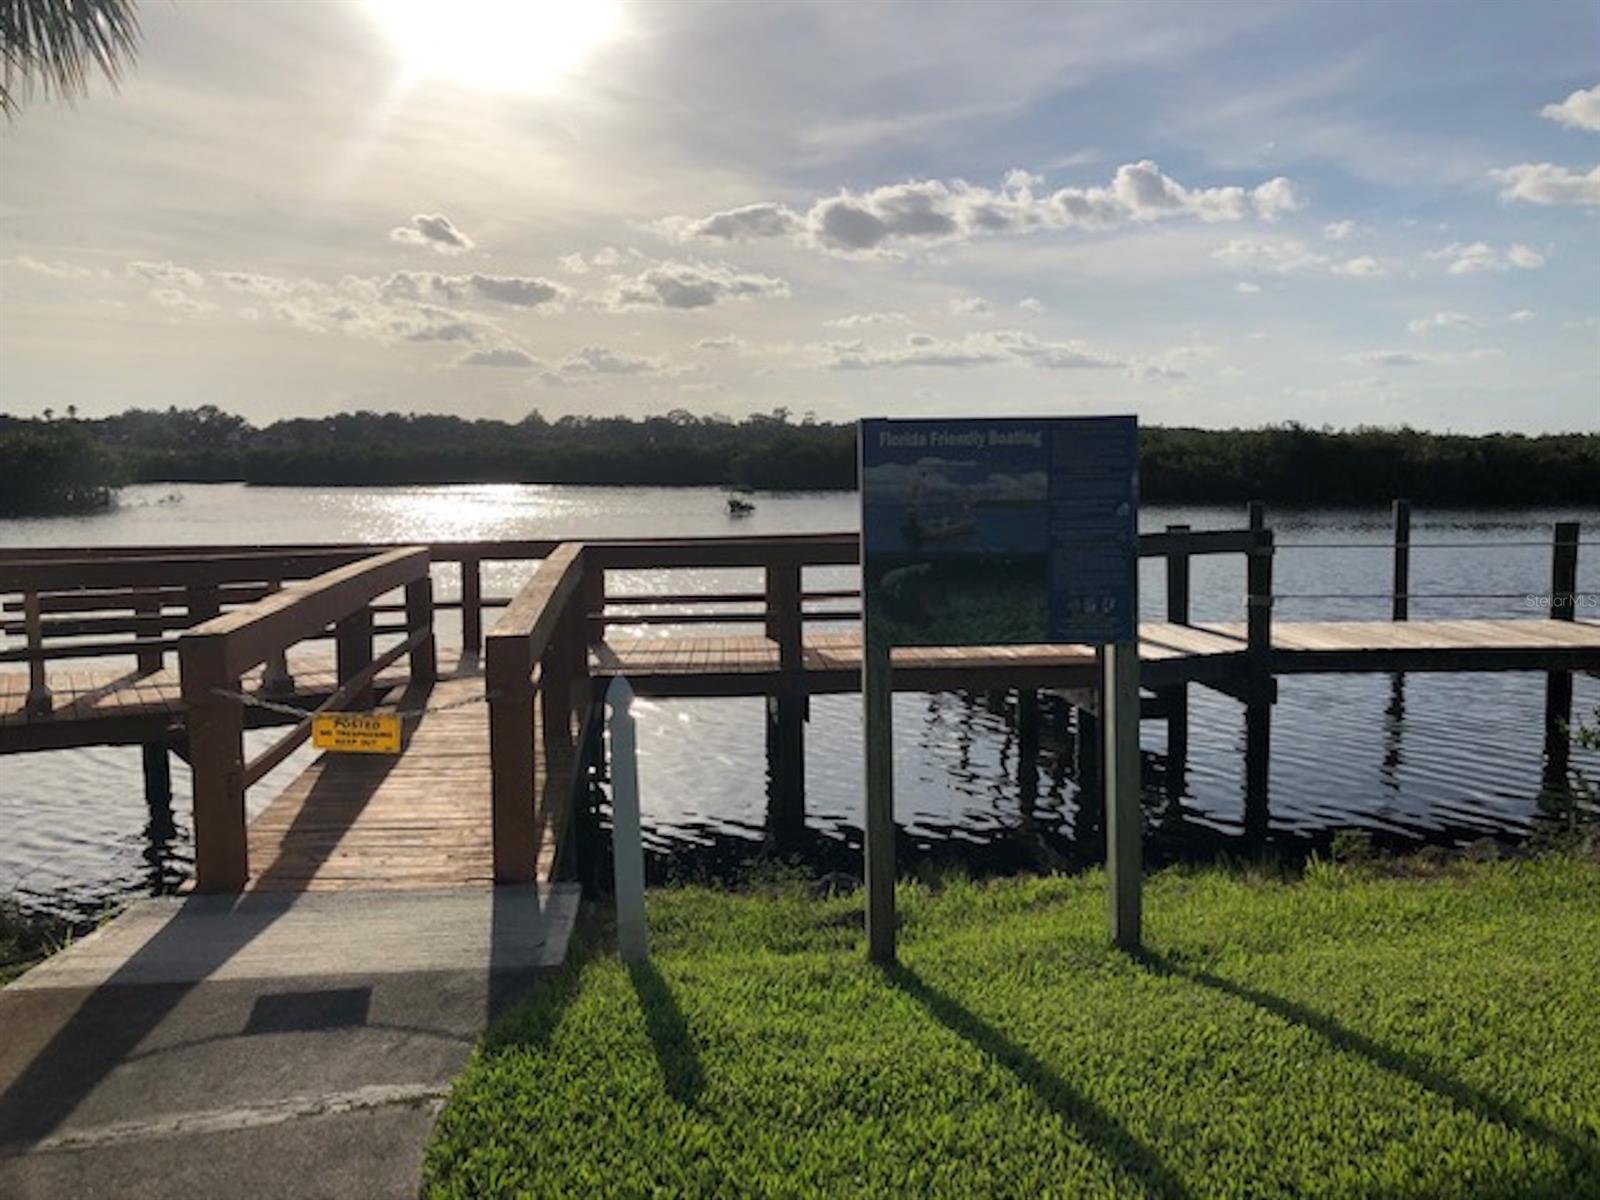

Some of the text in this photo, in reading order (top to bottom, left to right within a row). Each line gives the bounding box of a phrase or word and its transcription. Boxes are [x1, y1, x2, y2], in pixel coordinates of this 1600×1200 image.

[879, 429, 1042, 448] Florida Friendly Boating
[334, 718, 381, 729] POSTED
